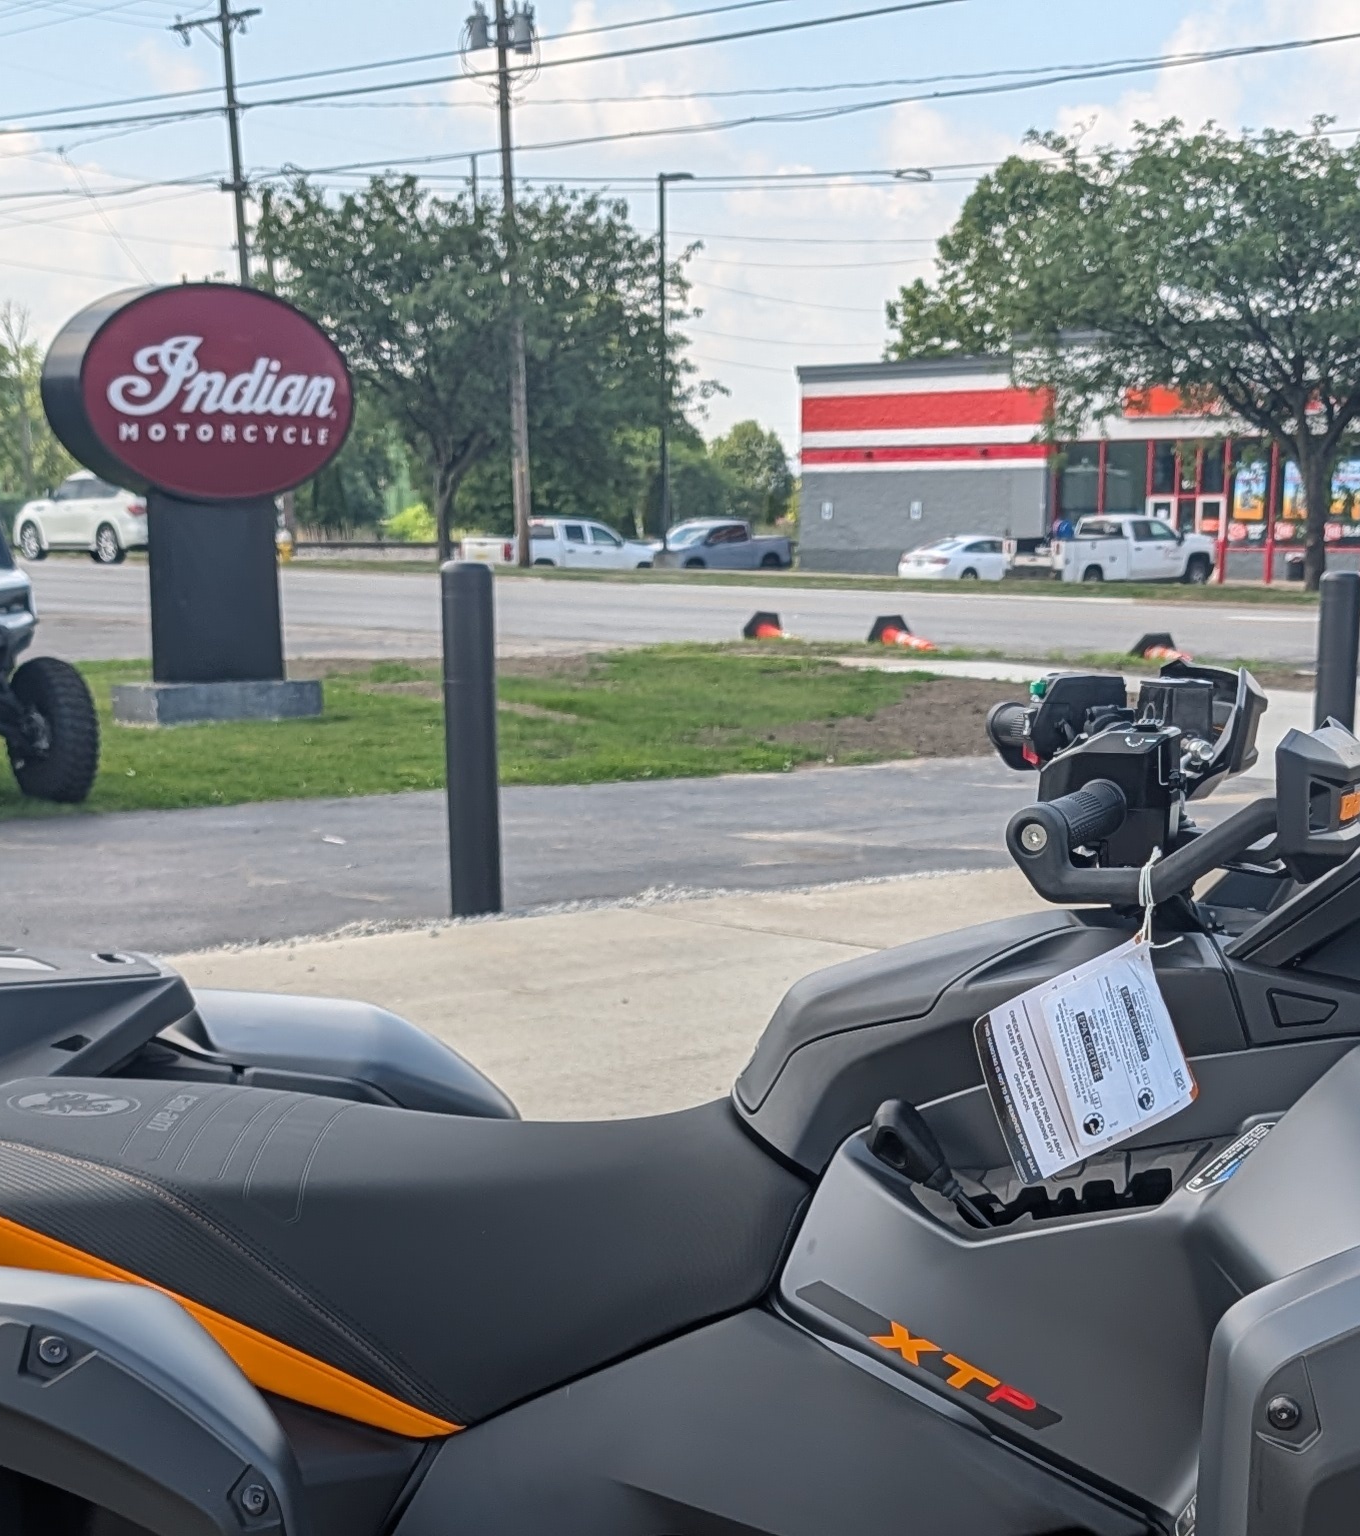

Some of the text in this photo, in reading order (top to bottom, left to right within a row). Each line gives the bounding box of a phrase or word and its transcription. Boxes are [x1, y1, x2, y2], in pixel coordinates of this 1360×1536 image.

[106, 335, 334, 418] Indian
[118, 423, 330, 445] MOTORCYCLE
[1077, 1013, 1088, 1035] EPA
[1121, 987, 1132, 1008] EPA
[1128, 1007, 1148, 1059] CERTIFIED
[996, 1072, 1005, 1086] NOT
[1000, 1085, 1007, 1095] TO
[1004, 1023, 1054, 1154] STATE OR LOCAL LAWS REGARDING ATV
[1007, 1009, 1065, 1161] CHECK WITH YOUR DEALER TO FIND OUT ABOUT
[868, 1321, 1037, 1411] XTP
